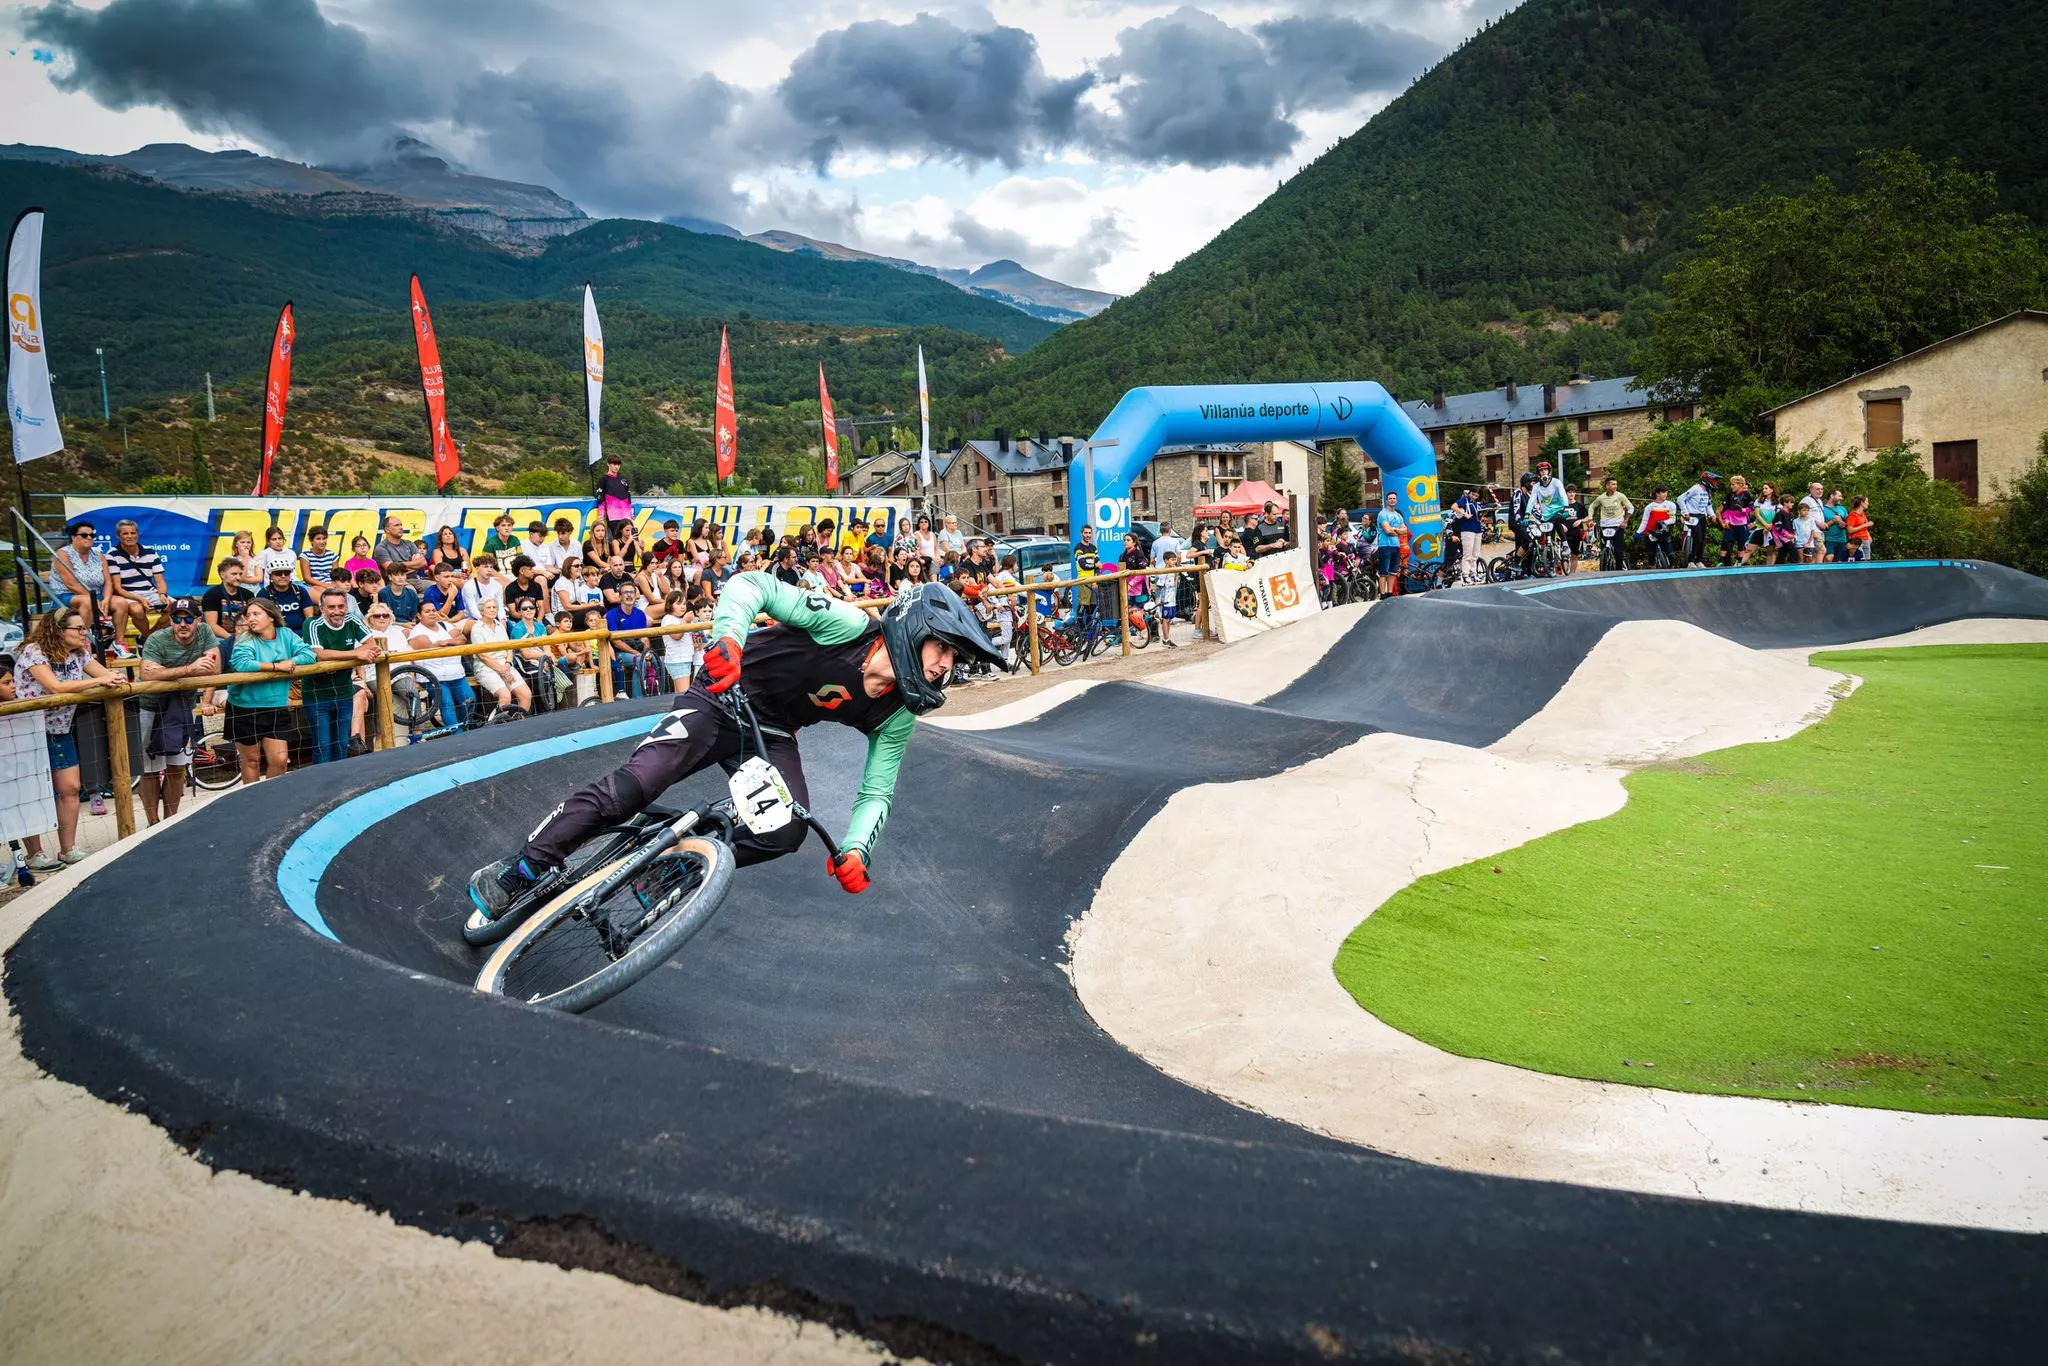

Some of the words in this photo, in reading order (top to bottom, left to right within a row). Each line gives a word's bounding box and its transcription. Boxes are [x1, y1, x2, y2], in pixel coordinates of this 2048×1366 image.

[1199, 404, 1255, 420] Villanúa
[1259, 402, 1309, 420] deporte
[180, 543, 190, 551] de
[745, 780, 780, 816] 14
